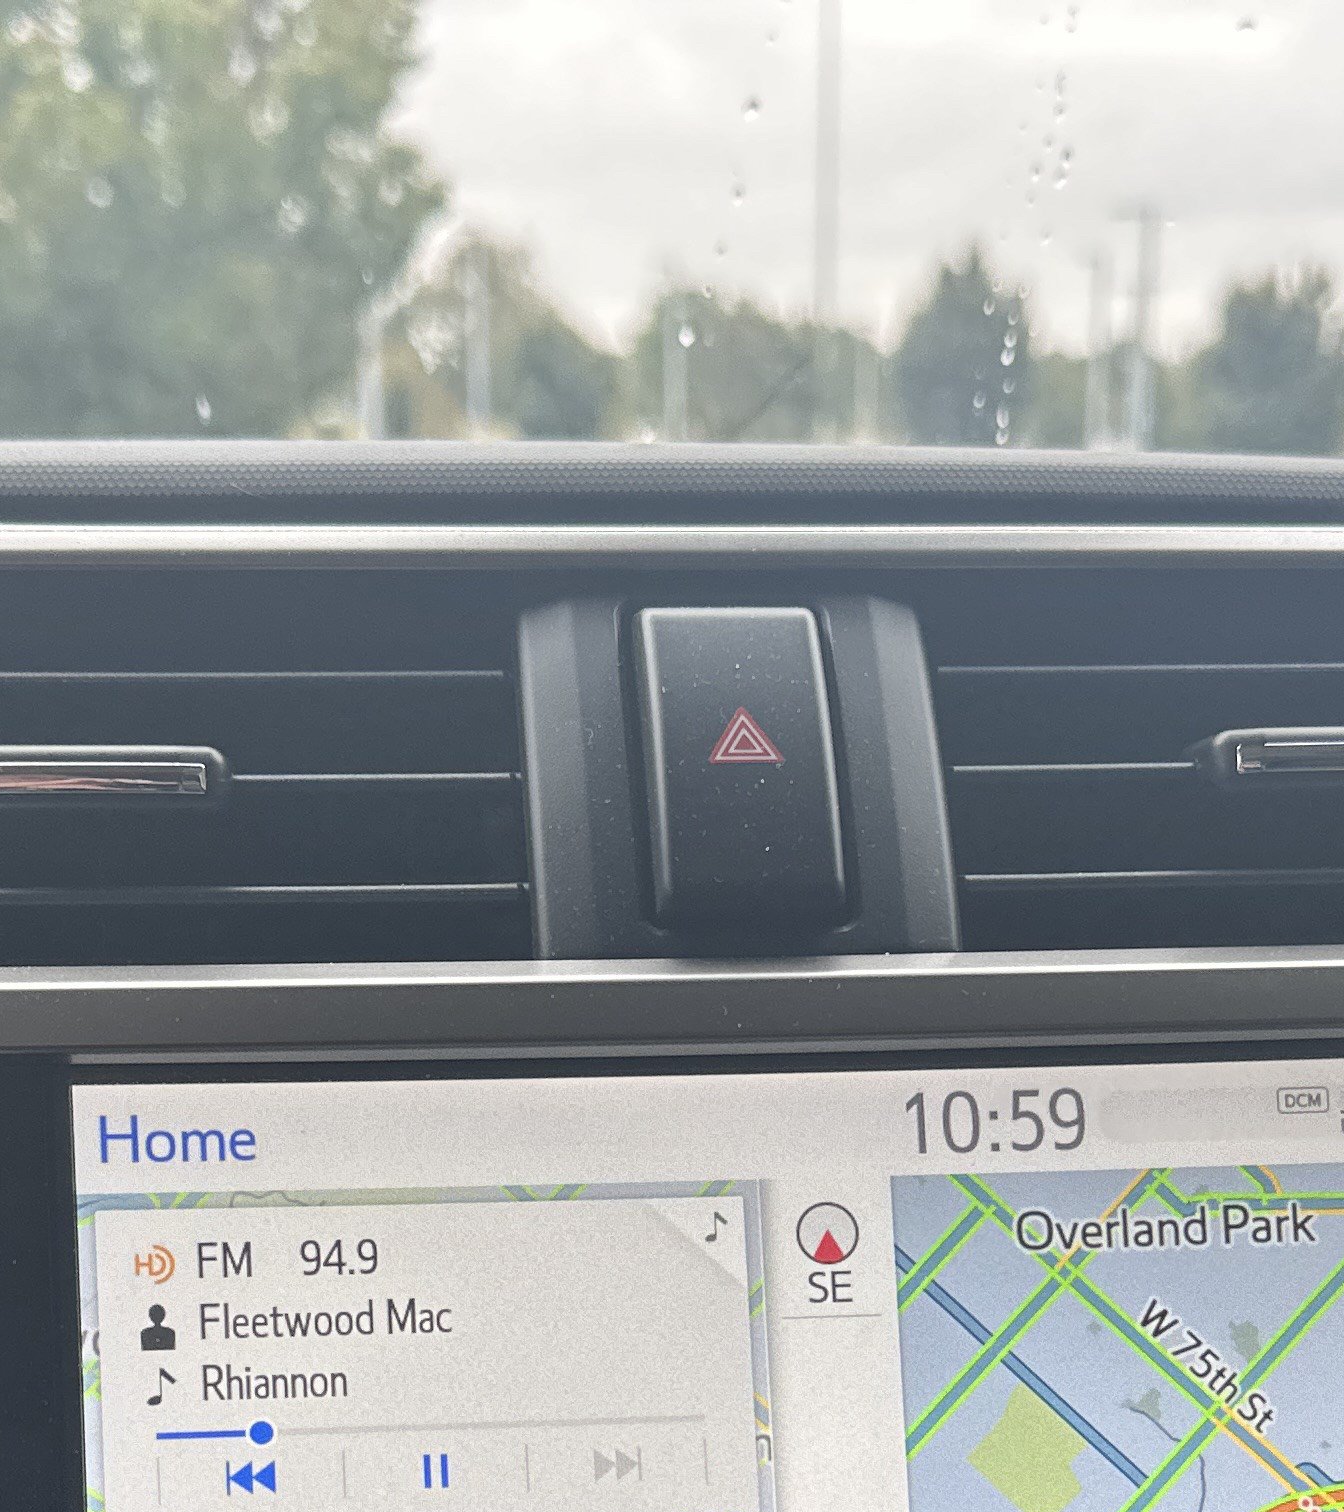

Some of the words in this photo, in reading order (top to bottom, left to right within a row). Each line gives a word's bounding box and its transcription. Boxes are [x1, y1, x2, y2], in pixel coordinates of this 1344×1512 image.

[905, 1086, 1086, 1155] 10:59
[1284, 1093, 1322, 1108] DCM
[99, 1115, 257, 1165] Home
[1016, 1206, 1207, 1252] Overland
[1223, 1201, 1316, 1245] Park
[197, 1241, 254, 1279] FM
[300, 1239, 378, 1276] 94.9
[808, 1270, 853, 1304] SE
[199, 1298, 375, 1340] Fleetwood
[387, 1300, 453, 1335] Mac
[201, 1364, 348, 1400] Rhiannon
[1140, 1299, 1180, 1338] W
[1170, 1329, 1237, 1404] 75th
[1236, 1392, 1274, 1433] St
